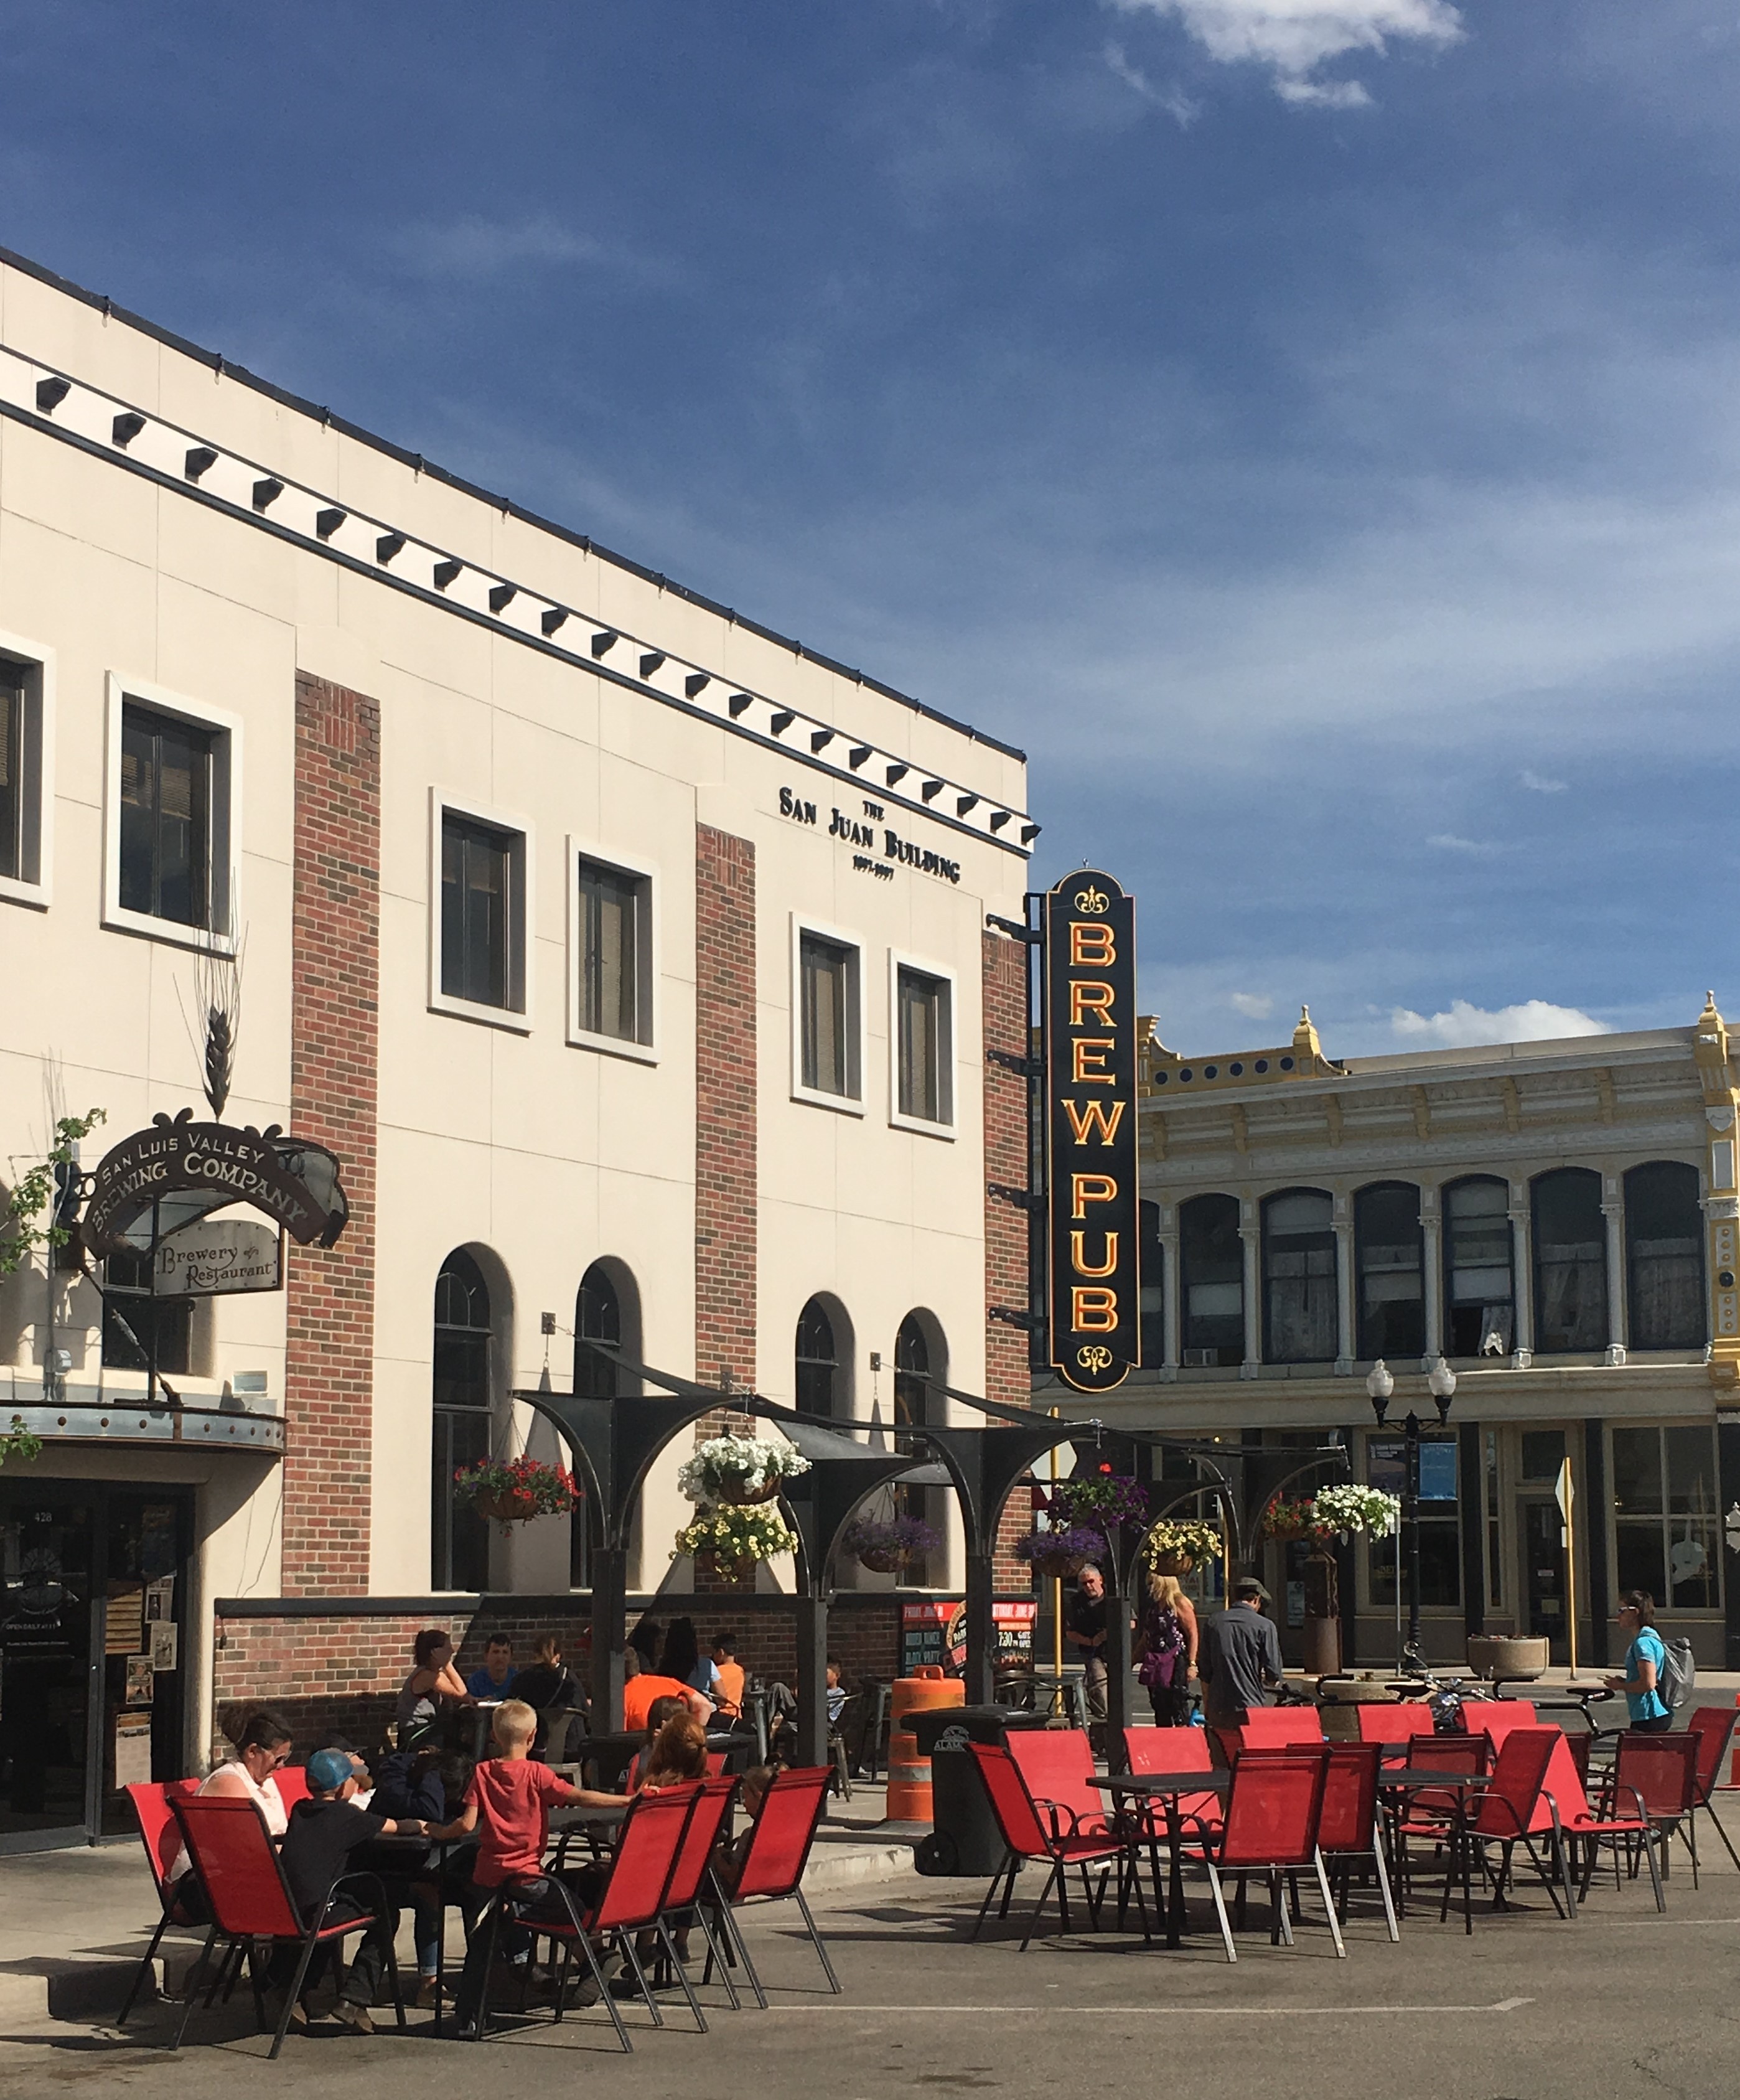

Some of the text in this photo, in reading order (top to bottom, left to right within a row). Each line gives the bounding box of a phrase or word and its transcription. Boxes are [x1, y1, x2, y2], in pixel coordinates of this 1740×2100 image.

[863, 800, 885, 822] THE
[1060, 921, 1126, 1332] BREW PUB
[102, 1132, 265, 1185] SAN LUIS VALLEY
[91, 1152, 309, 1233] BREWING COMPANY
[161, 1245, 238, 1274] Brewery
[187, 1262, 273, 1288] Restaurant
[34, 1512, 52, 1522] 428
[934, 1741, 967, 1752] ALAM
